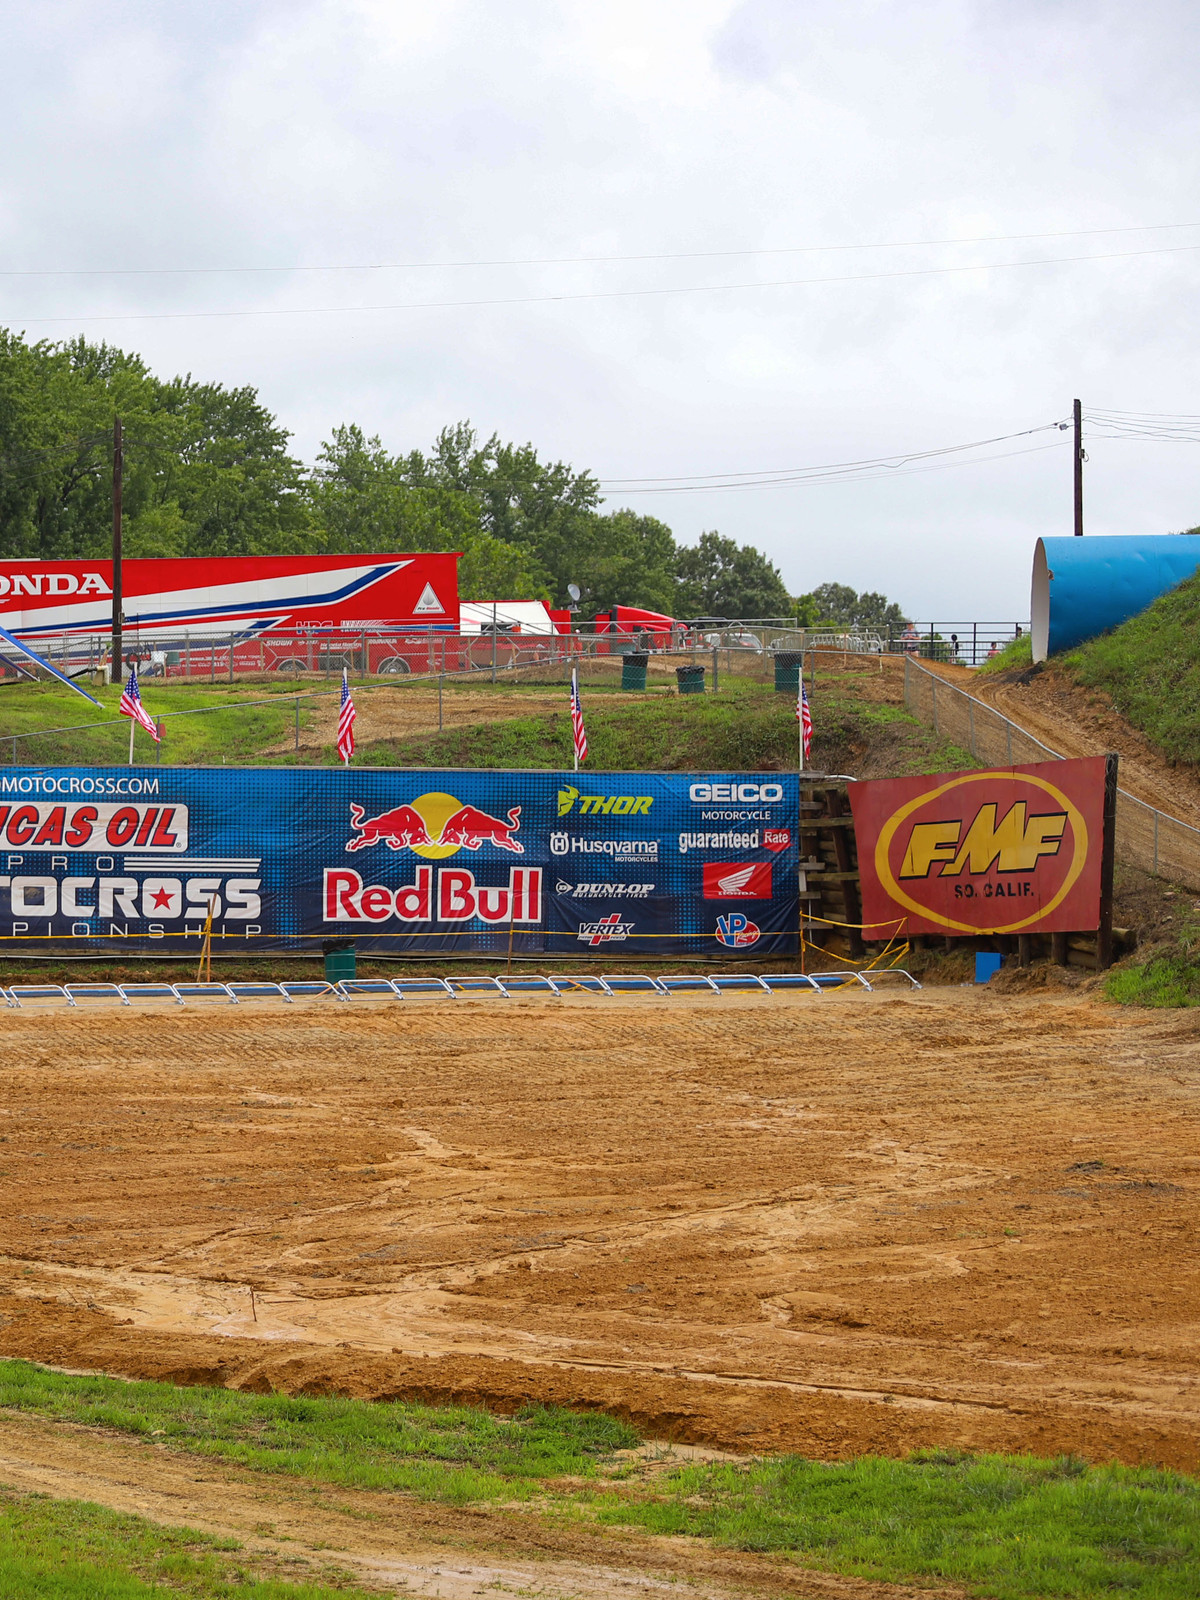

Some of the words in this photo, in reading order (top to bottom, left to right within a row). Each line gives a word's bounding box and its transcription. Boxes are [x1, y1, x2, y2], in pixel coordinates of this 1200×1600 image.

[689, 783, 783, 802] GEICO
[579, 796, 654, 814] THOR
[701, 811, 771, 820] MOTORCYCLE
[106, 806, 178, 847] OIL
[571, 837, 658, 855] Husqvarna
[679, 829, 759, 853] guaranteed
[764, 831, 789, 844] Rate
[898, 800, 1068, 880] FMF
[7, 855, 114, 871] PRO
[324, 866, 432, 922] Red
[438, 866, 542, 923] Bull
[574, 883, 655, 893] DUNLOP
[954, 884, 978, 898] SO.
[983, 882, 1034, 898] CALIF.
[579, 923, 635, 935] VERTEX
[716, 913, 747, 946] VP
